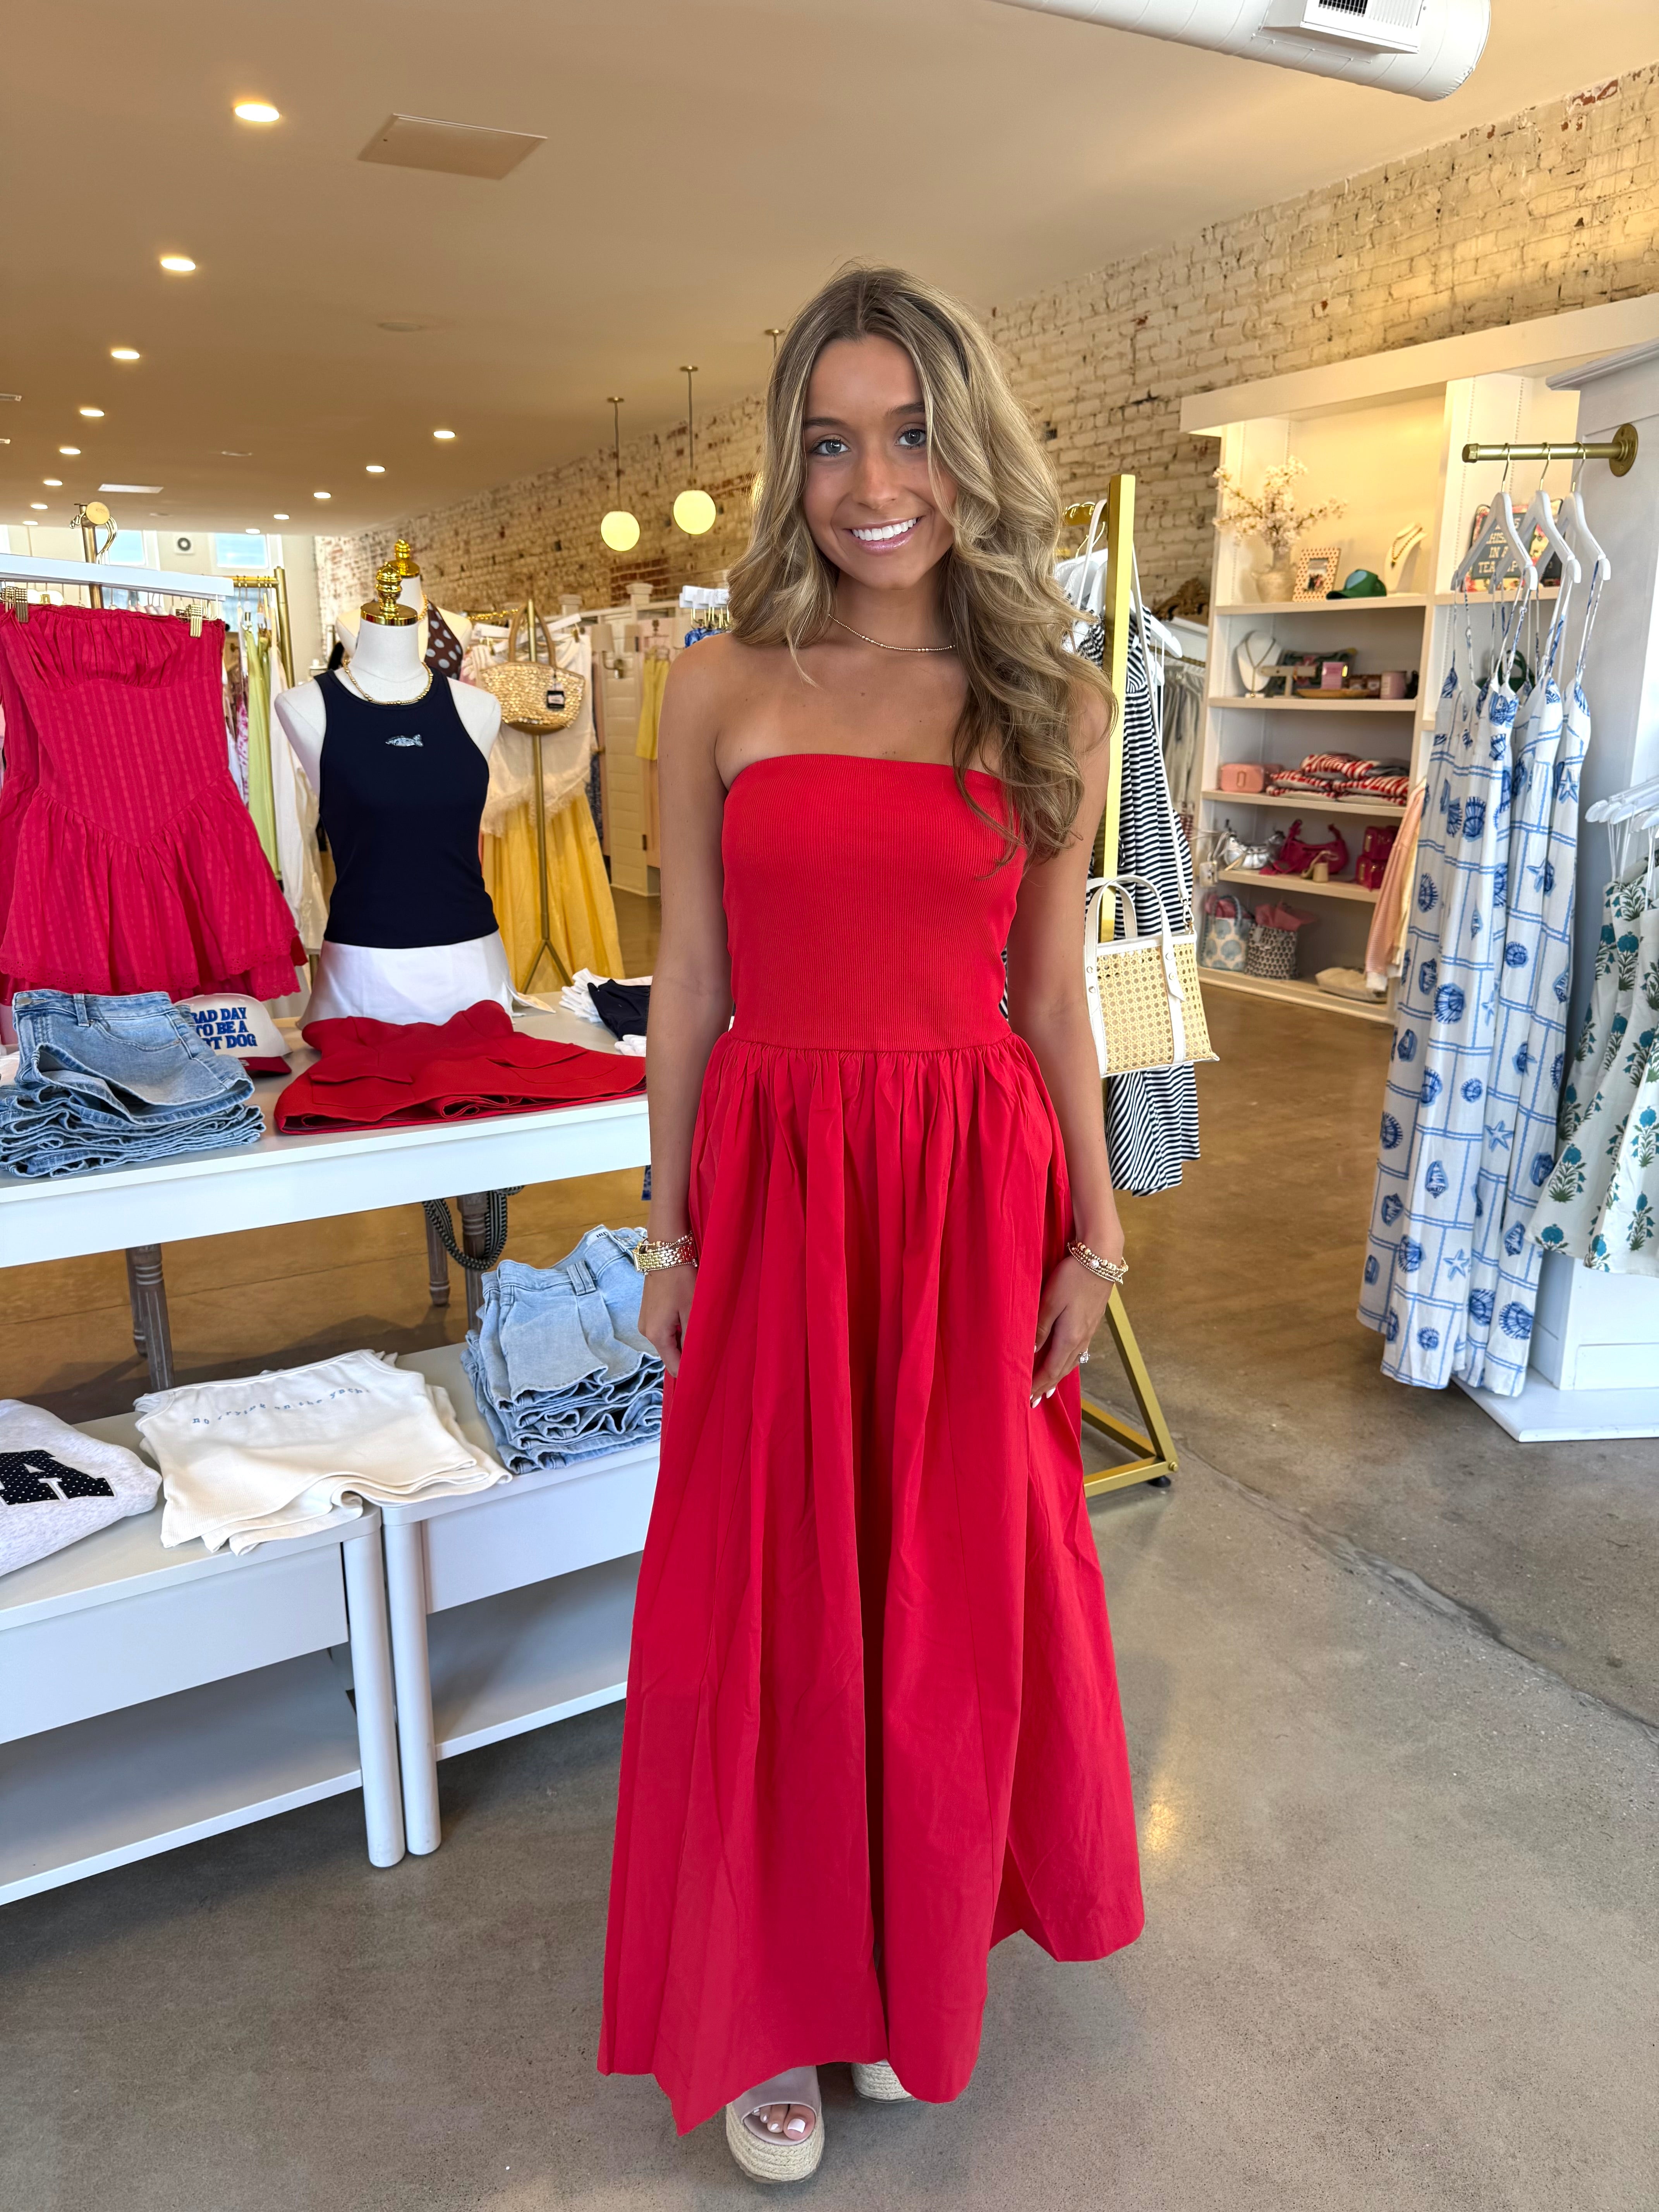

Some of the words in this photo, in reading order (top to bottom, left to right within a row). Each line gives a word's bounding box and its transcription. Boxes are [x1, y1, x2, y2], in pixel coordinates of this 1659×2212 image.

[220, 1007, 247, 1021] DAY
[215, 1021, 236, 1034] BE
[238, 1020, 249, 1033] A
[225, 1034, 258, 1049] DOG
